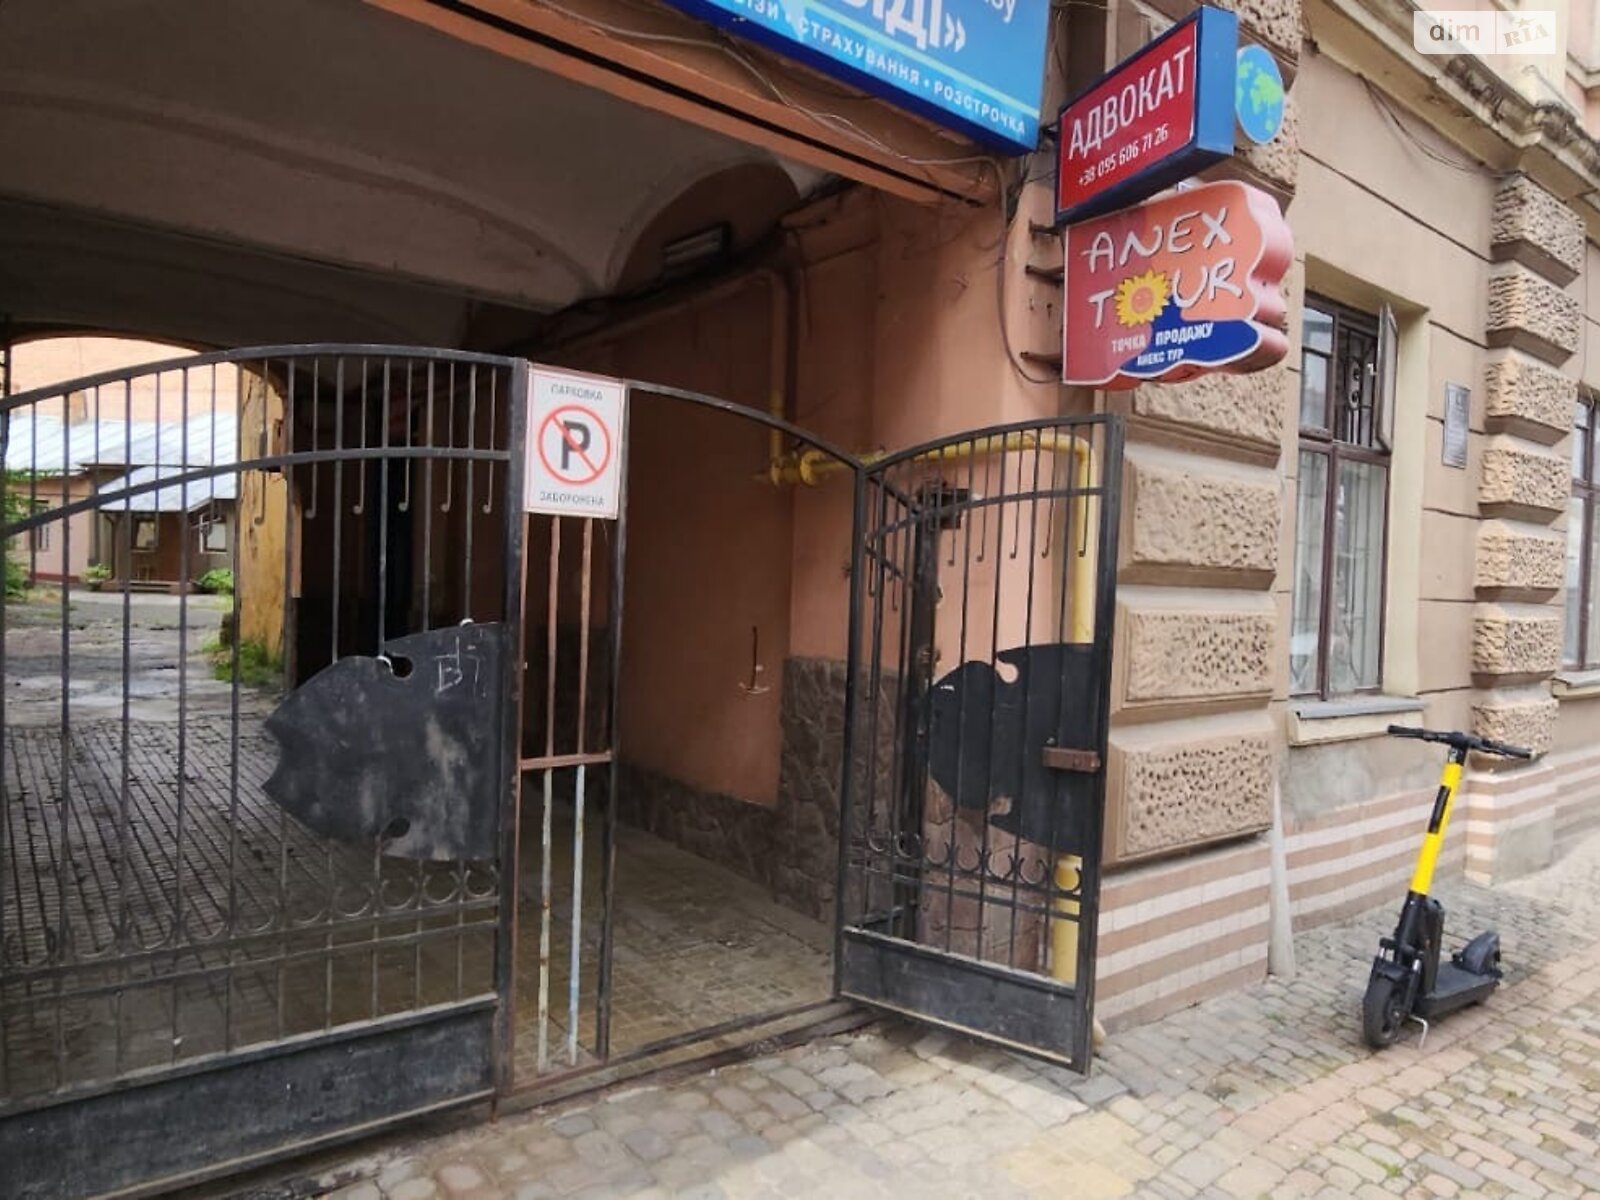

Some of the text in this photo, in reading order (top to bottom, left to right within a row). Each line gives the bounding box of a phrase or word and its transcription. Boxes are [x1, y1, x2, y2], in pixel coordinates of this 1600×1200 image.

[799, 16, 920, 86] СТРАХУВАННЯ
[934, 80, 1025, 136] РОЗСТРОЧКА
[1068, 46, 1191, 160] АДВОКАТ
[1097, 153, 1117, 178] 095
[1119, 140, 1139, 166] 606
[1142, 132, 1153, 153] 71
[1154, 122, 1169, 147] 26
[1081, 207, 1232, 273] ANEX
[1112, 321, 1214, 353] ТОЧКА ПРОДАЖУ
[1137, 347, 1184, 366] АНЕКС ТУР
[550, 383, 603, 401] ПАРКОВКА
[539, 491, 604, 507] ЗАБОРОНЕНА
